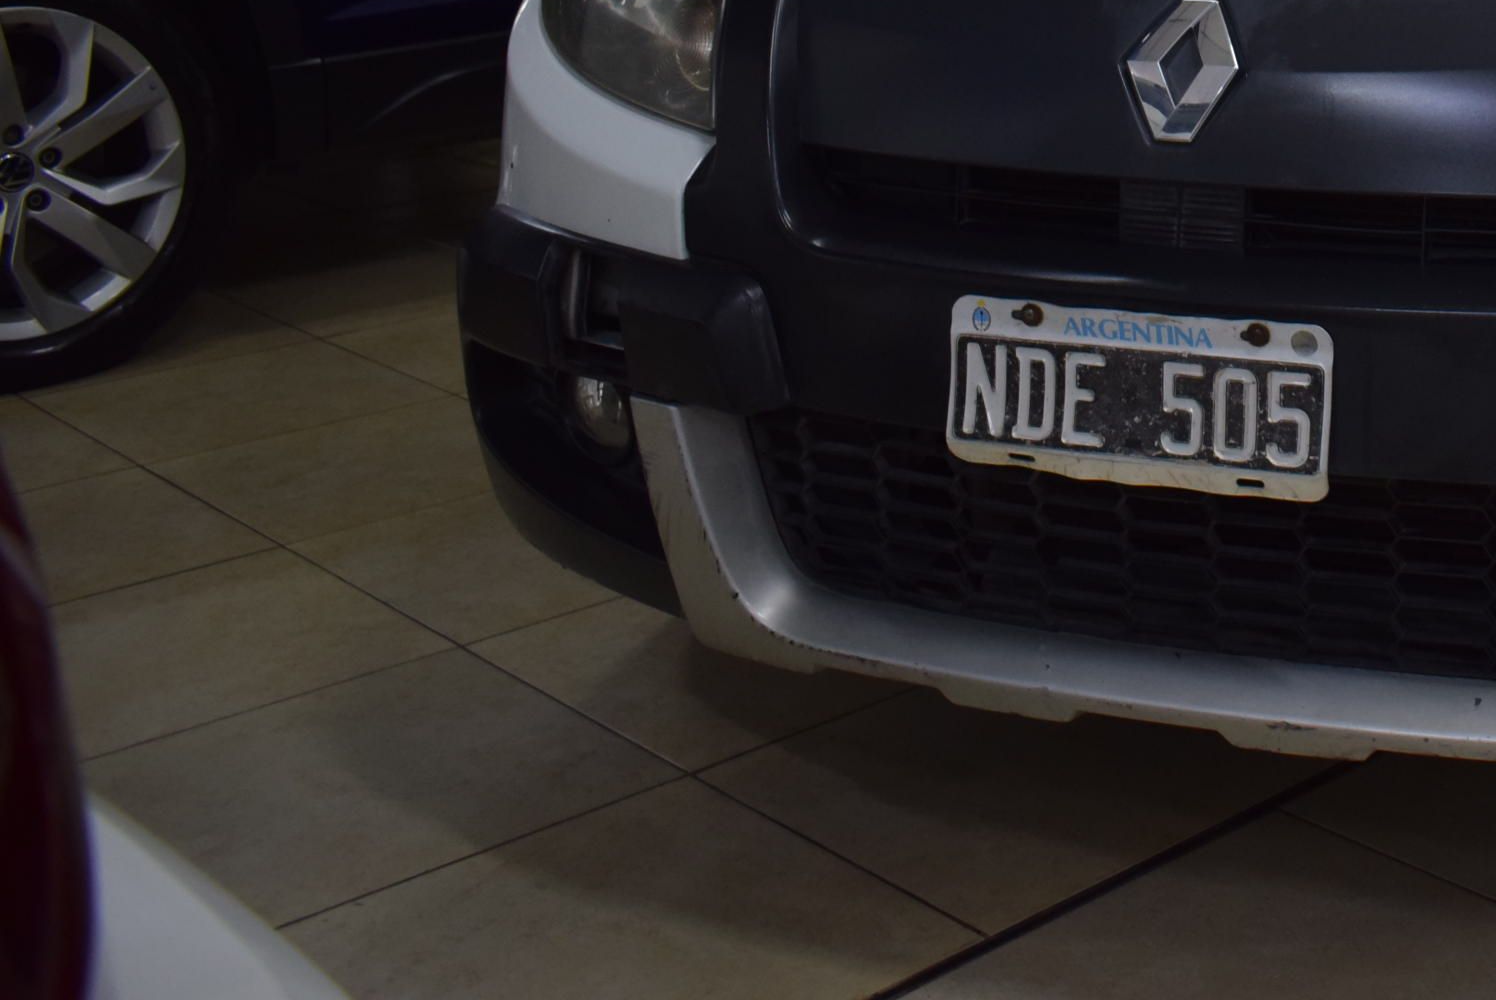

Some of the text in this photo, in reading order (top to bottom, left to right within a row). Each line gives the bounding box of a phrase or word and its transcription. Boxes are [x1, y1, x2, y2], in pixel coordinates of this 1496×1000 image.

[1063, 316, 1213, 349] ARGENTINA
[961, 341, 1312, 468] NDE 505
